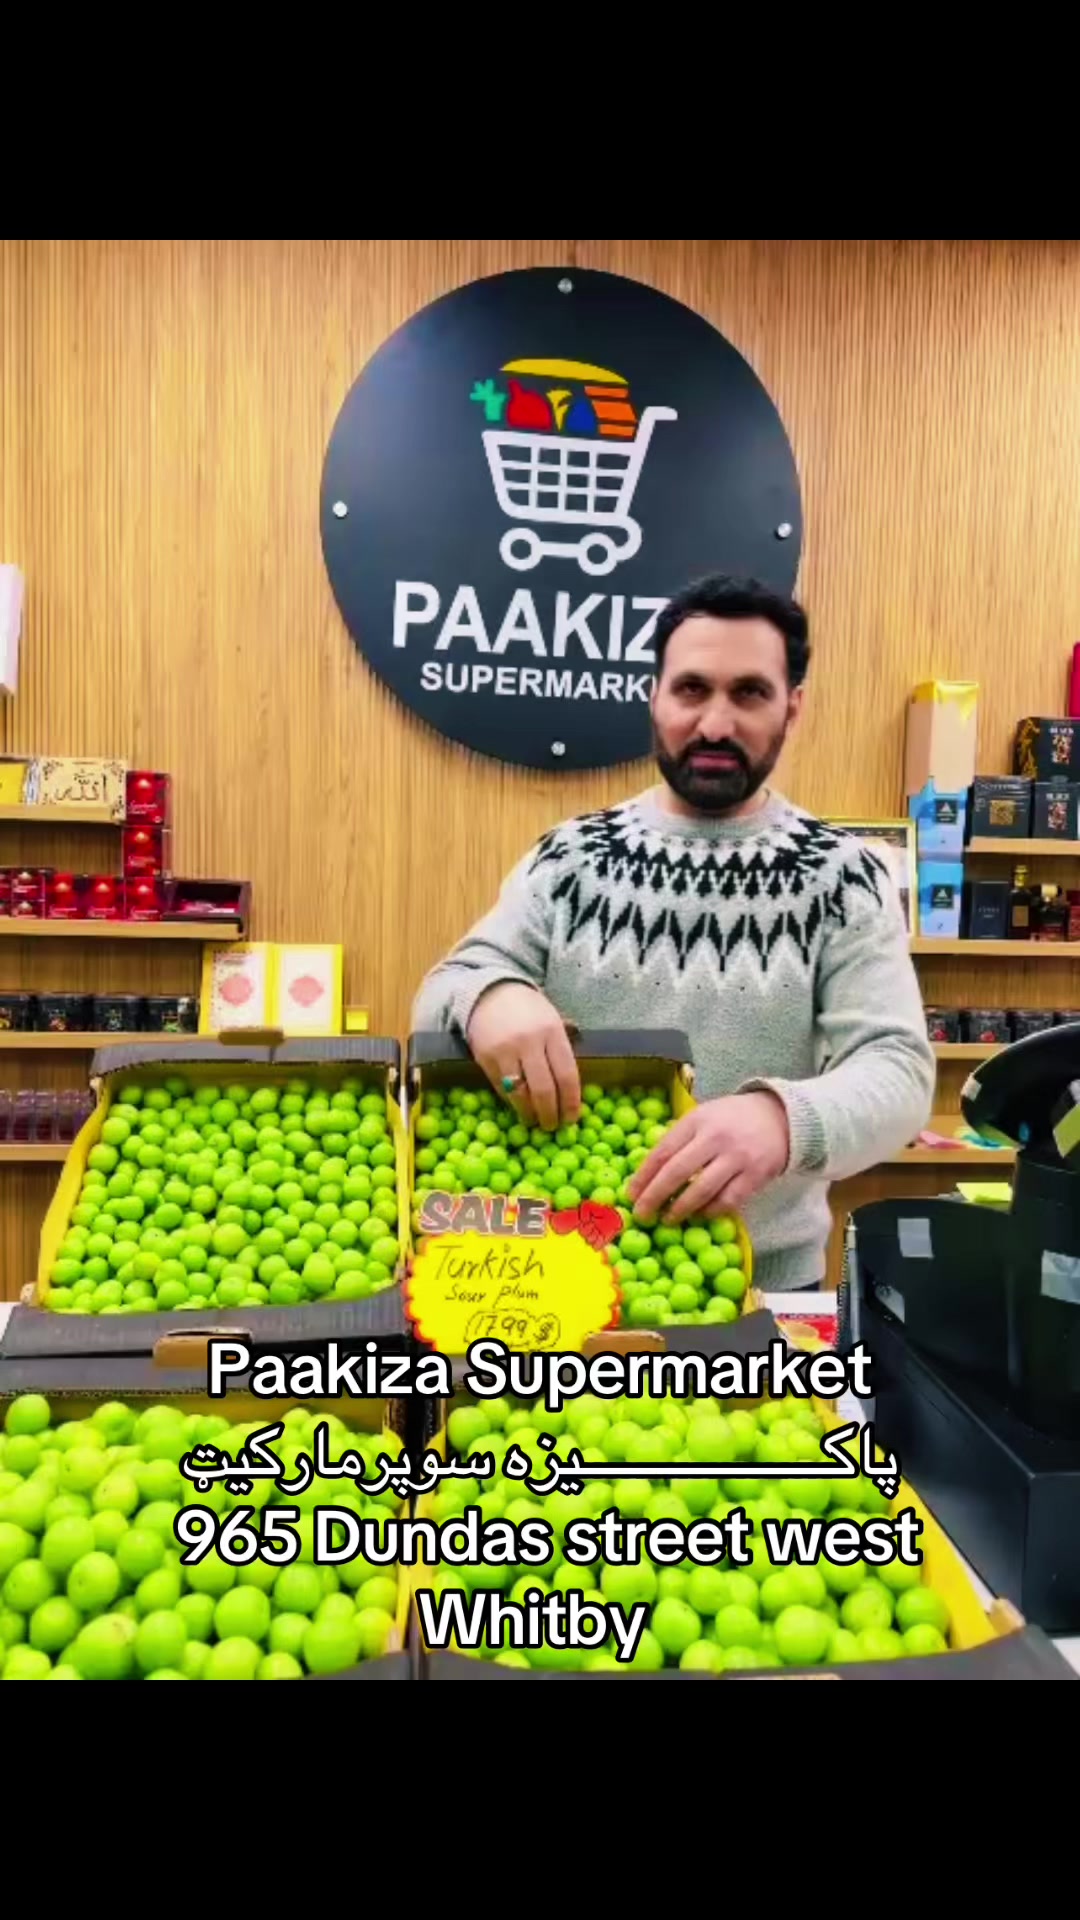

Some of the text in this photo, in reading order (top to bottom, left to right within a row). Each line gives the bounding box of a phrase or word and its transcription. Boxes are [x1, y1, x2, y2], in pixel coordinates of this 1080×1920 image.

[393, 580, 671, 663] PAAKIZ
[420, 662, 657, 702] SUPERMARK
[420, 1190, 549, 1237] SALE
[435, 1243, 545, 1280] Turkish
[445, 1284, 486, 1302] Sour
